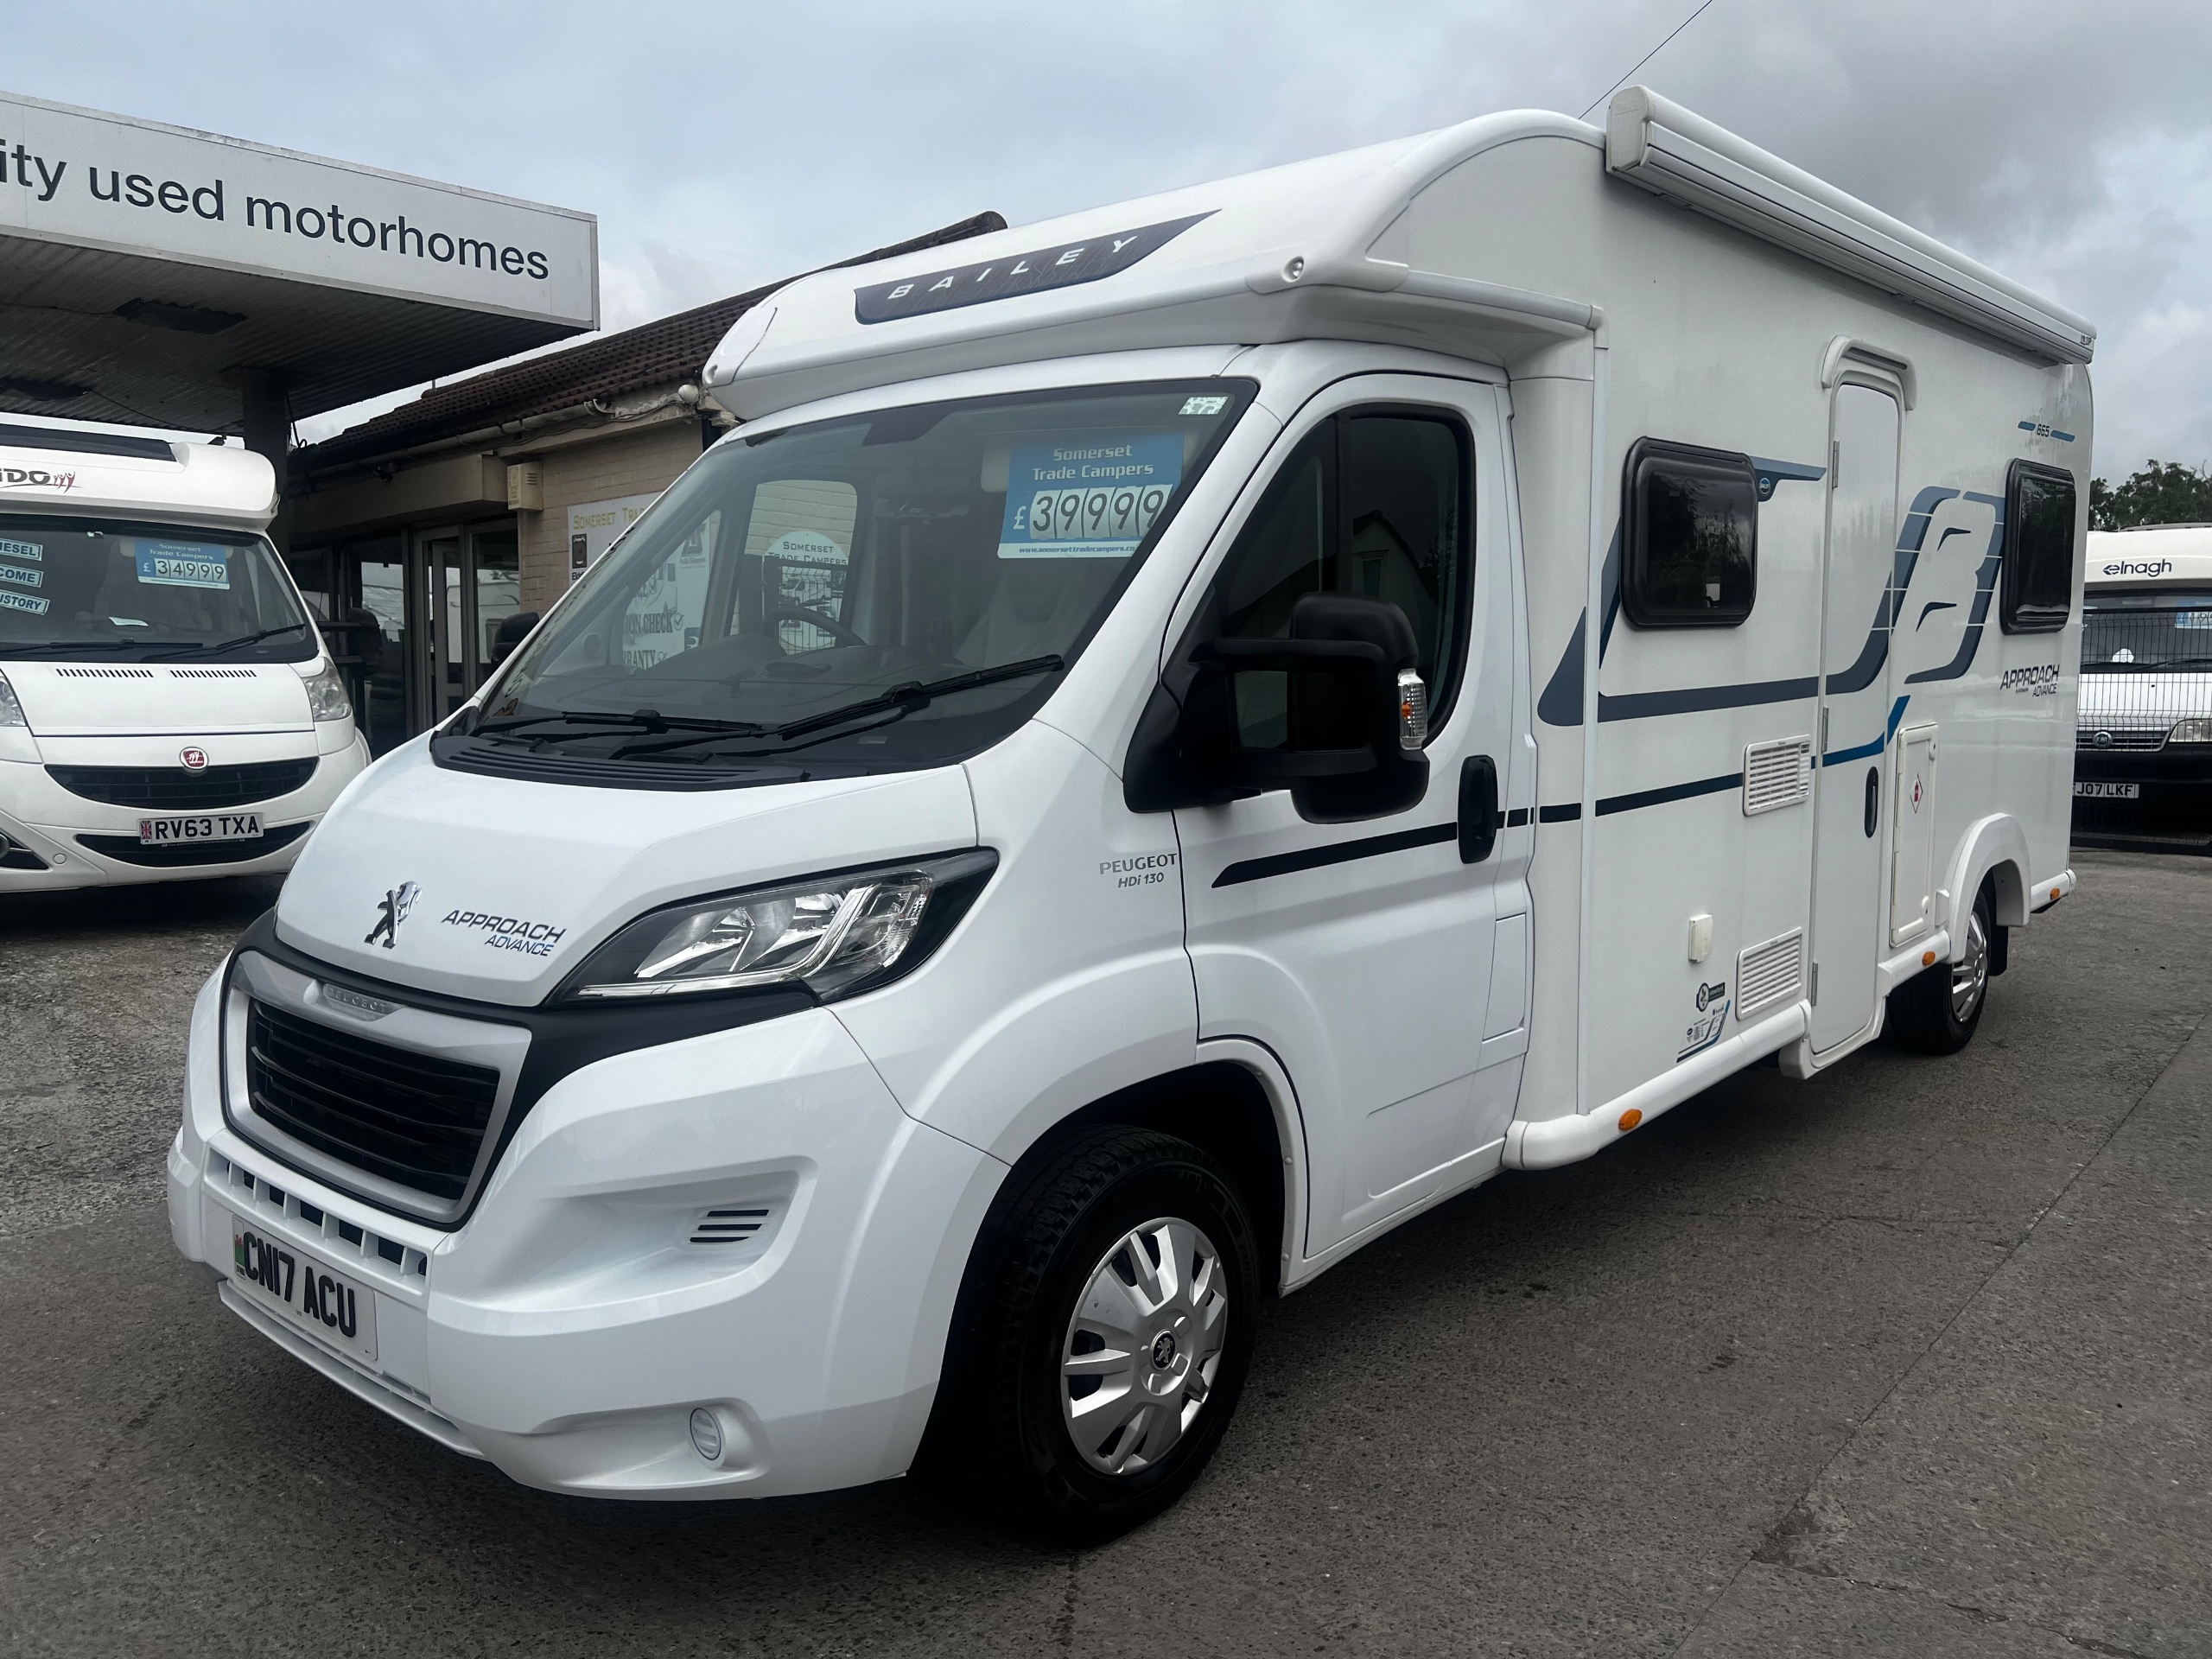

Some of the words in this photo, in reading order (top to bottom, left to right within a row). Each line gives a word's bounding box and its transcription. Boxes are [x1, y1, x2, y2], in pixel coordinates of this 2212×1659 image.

[0, 138, 67, 201] ity
[90, 167, 225, 221] used
[246, 196, 550, 279] motorhomes
[887, 236, 1137, 300] BAILEY
[2037, 423, 2050, 437] 665
[1052, 443, 1133, 461] Somerset
[1033, 466, 1076, 481] Trade
[1081, 463, 1154, 480] Campers
[573, 512, 616, 530] SOMERSET
[159, 543, 202, 552] Somerset
[175, 551, 214, 560] Campers
[783, 541, 834, 553] SOMERSET
[804, 555, 846, 565] CAMPERS
[2102, 558, 2171, 577] elnagh
[624, 613, 642, 634] ION
[643, 612, 673, 634] CHECK
[2000, 664, 2060, 690] APPROACH
[2032, 683, 2057, 697] ADVANCE
[2074, 783, 2102, 795] J07
[2107, 784, 2133, 796] LKF
[156, 818, 212, 839] RV63
[219, 816, 259, 835] TXA
[1099, 853, 1177, 874] PEUGEOT
[1117, 874, 1141, 888] HDi
[1144, 872, 1164, 884] 130
[441, 910, 567, 943] APPROACH
[484, 934, 555, 957] ADVANCE
[243, 1231, 295, 1302] CN17
[303, 1266, 356, 1338] ACU
